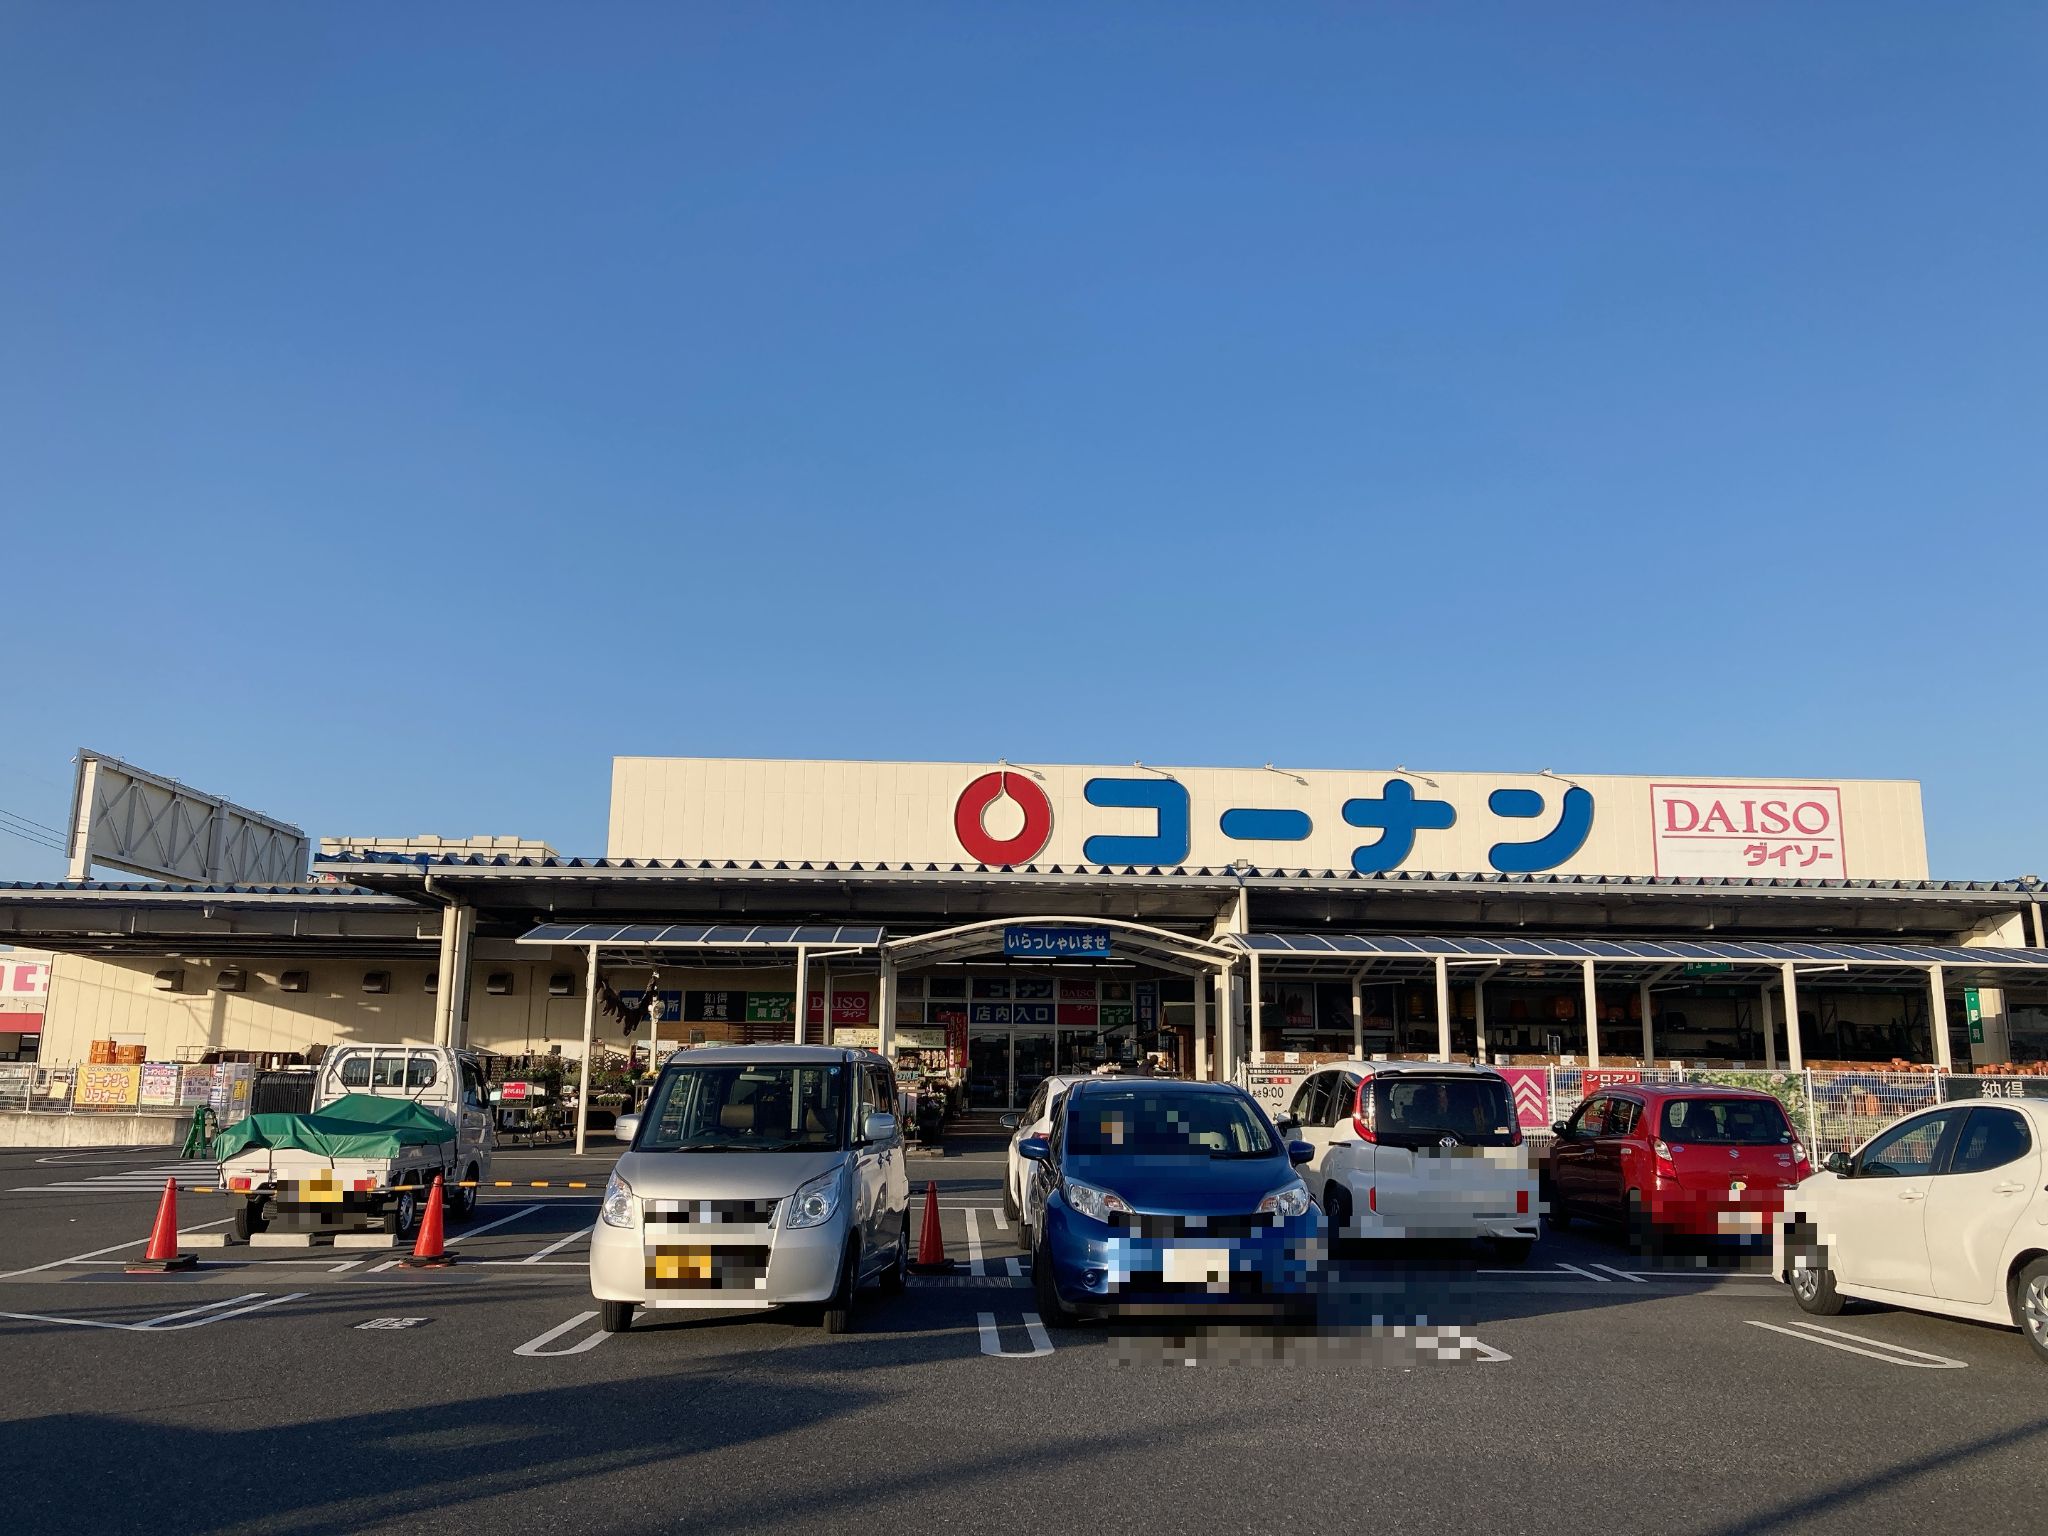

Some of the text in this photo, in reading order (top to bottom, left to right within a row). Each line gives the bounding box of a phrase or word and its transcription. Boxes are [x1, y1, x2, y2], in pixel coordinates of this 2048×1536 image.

[1663, 800, 1830, 834] DAISO
[1084, 778, 1594, 873] コーナン
[1744, 842, 1833, 867] ダイソー
[1008, 933, 1107, 950] いらっしゃいませ
[989, 984, 1050, 997] コーナン
[749, 997, 790, 1007] コーナン
[975, 1006, 1049, 1022] 店内入口
[1101, 1007, 1131, 1016] コーナン
[87, 1072, 130, 1088] コーナンで
[1586, 1073, 1636, 1082] シロアリ
[84, 1088, 128, 1103] リフォーム
[1981, 1080, 2025, 1099] 納得
